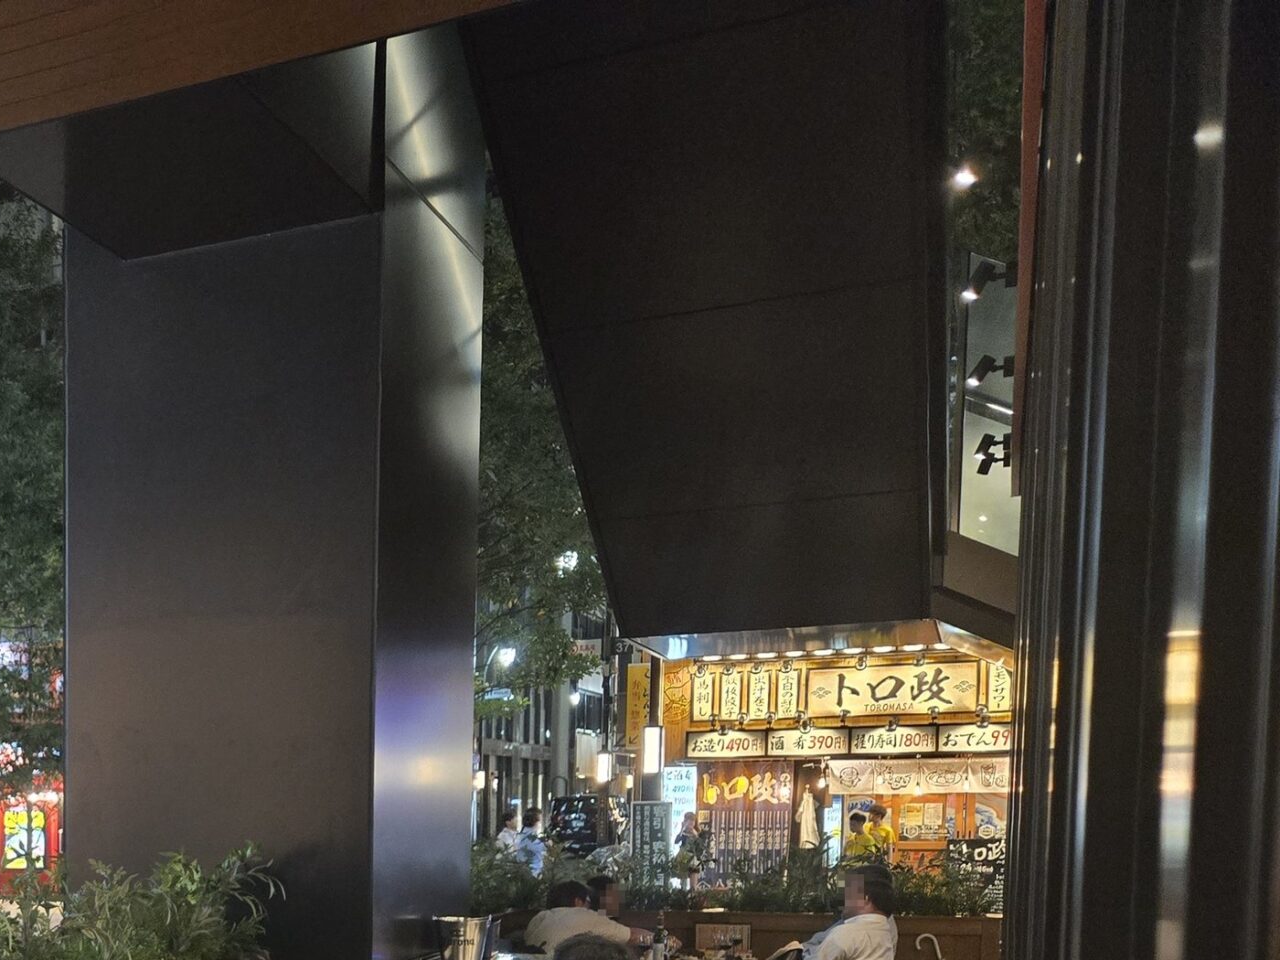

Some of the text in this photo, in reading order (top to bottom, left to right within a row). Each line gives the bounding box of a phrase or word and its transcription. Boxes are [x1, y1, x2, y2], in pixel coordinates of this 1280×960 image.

[615, 642, 630, 653] 37
[836, 667, 953, 708] トロ政
[863, 702, 915, 713] TOROMASA
